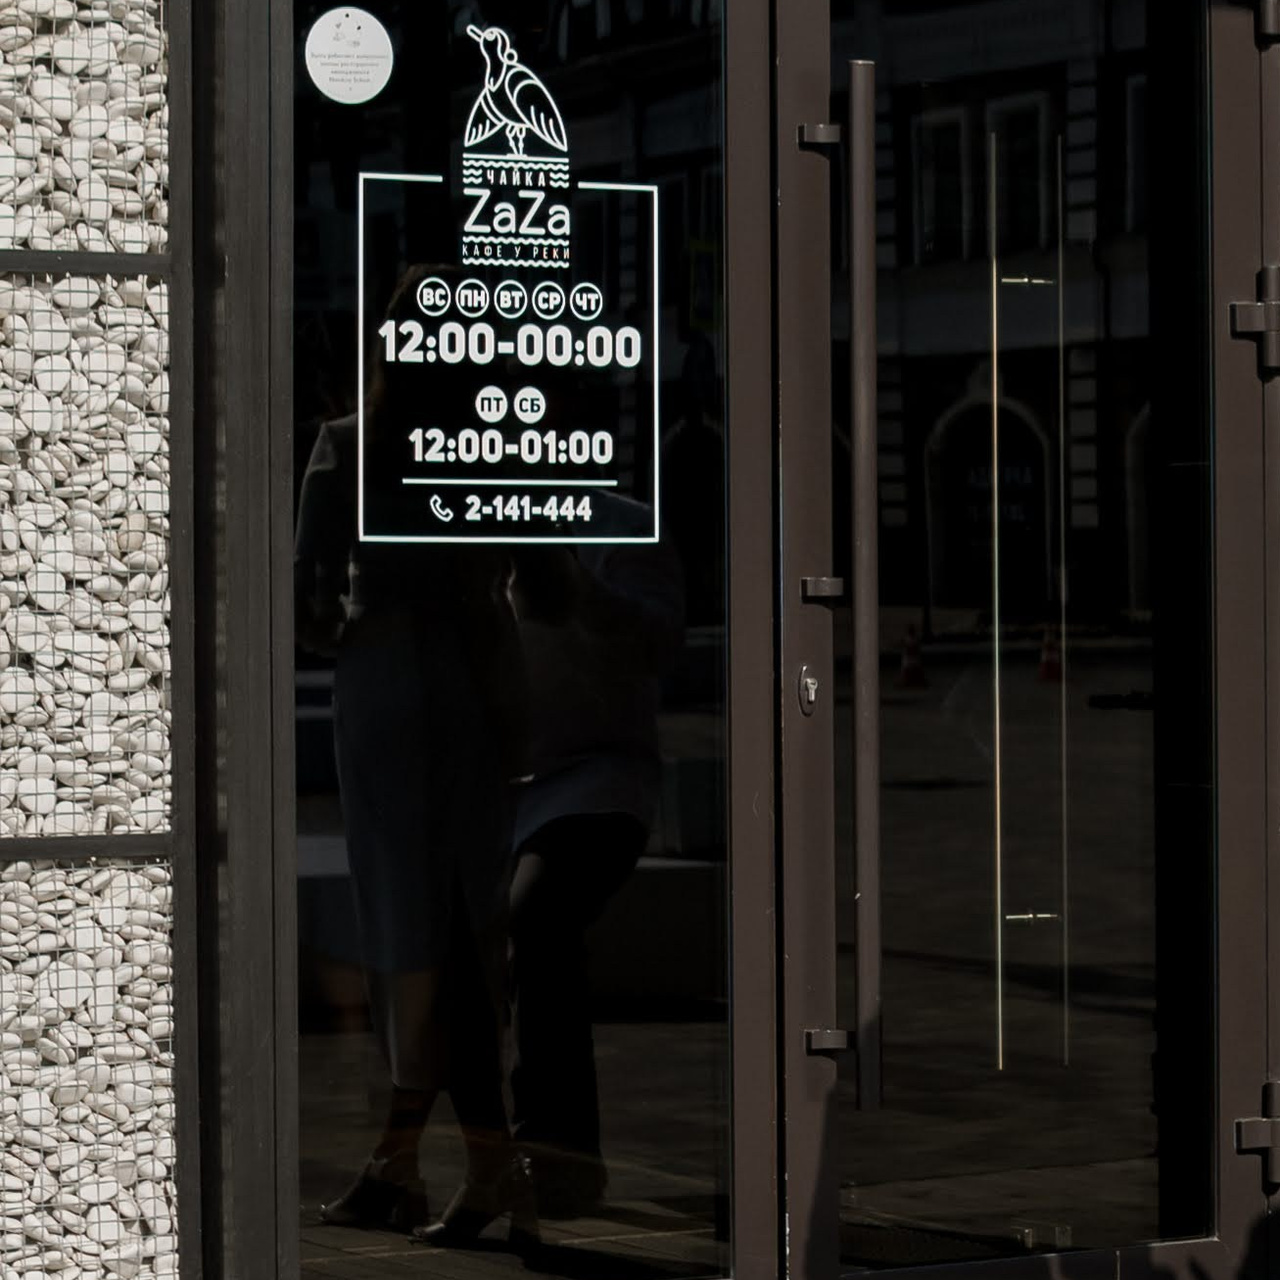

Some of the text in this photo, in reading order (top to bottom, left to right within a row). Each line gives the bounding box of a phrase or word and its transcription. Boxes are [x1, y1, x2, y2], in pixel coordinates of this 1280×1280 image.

[486, 167, 546, 187] ЧАЙКА
[463, 187, 571, 236] ZaZa
[462, 243, 570, 260] КАФЕ У РЕКИ
[422, 287, 600, 312] ВС ПН ВТ СР ЧТ
[378, 320, 641, 368] 12:00-00:00
[480, 397, 541, 413] ПТ СБ
[408, 428, 613, 465] 12:00-01:00
[465, 494, 592, 522] 2-141-444
